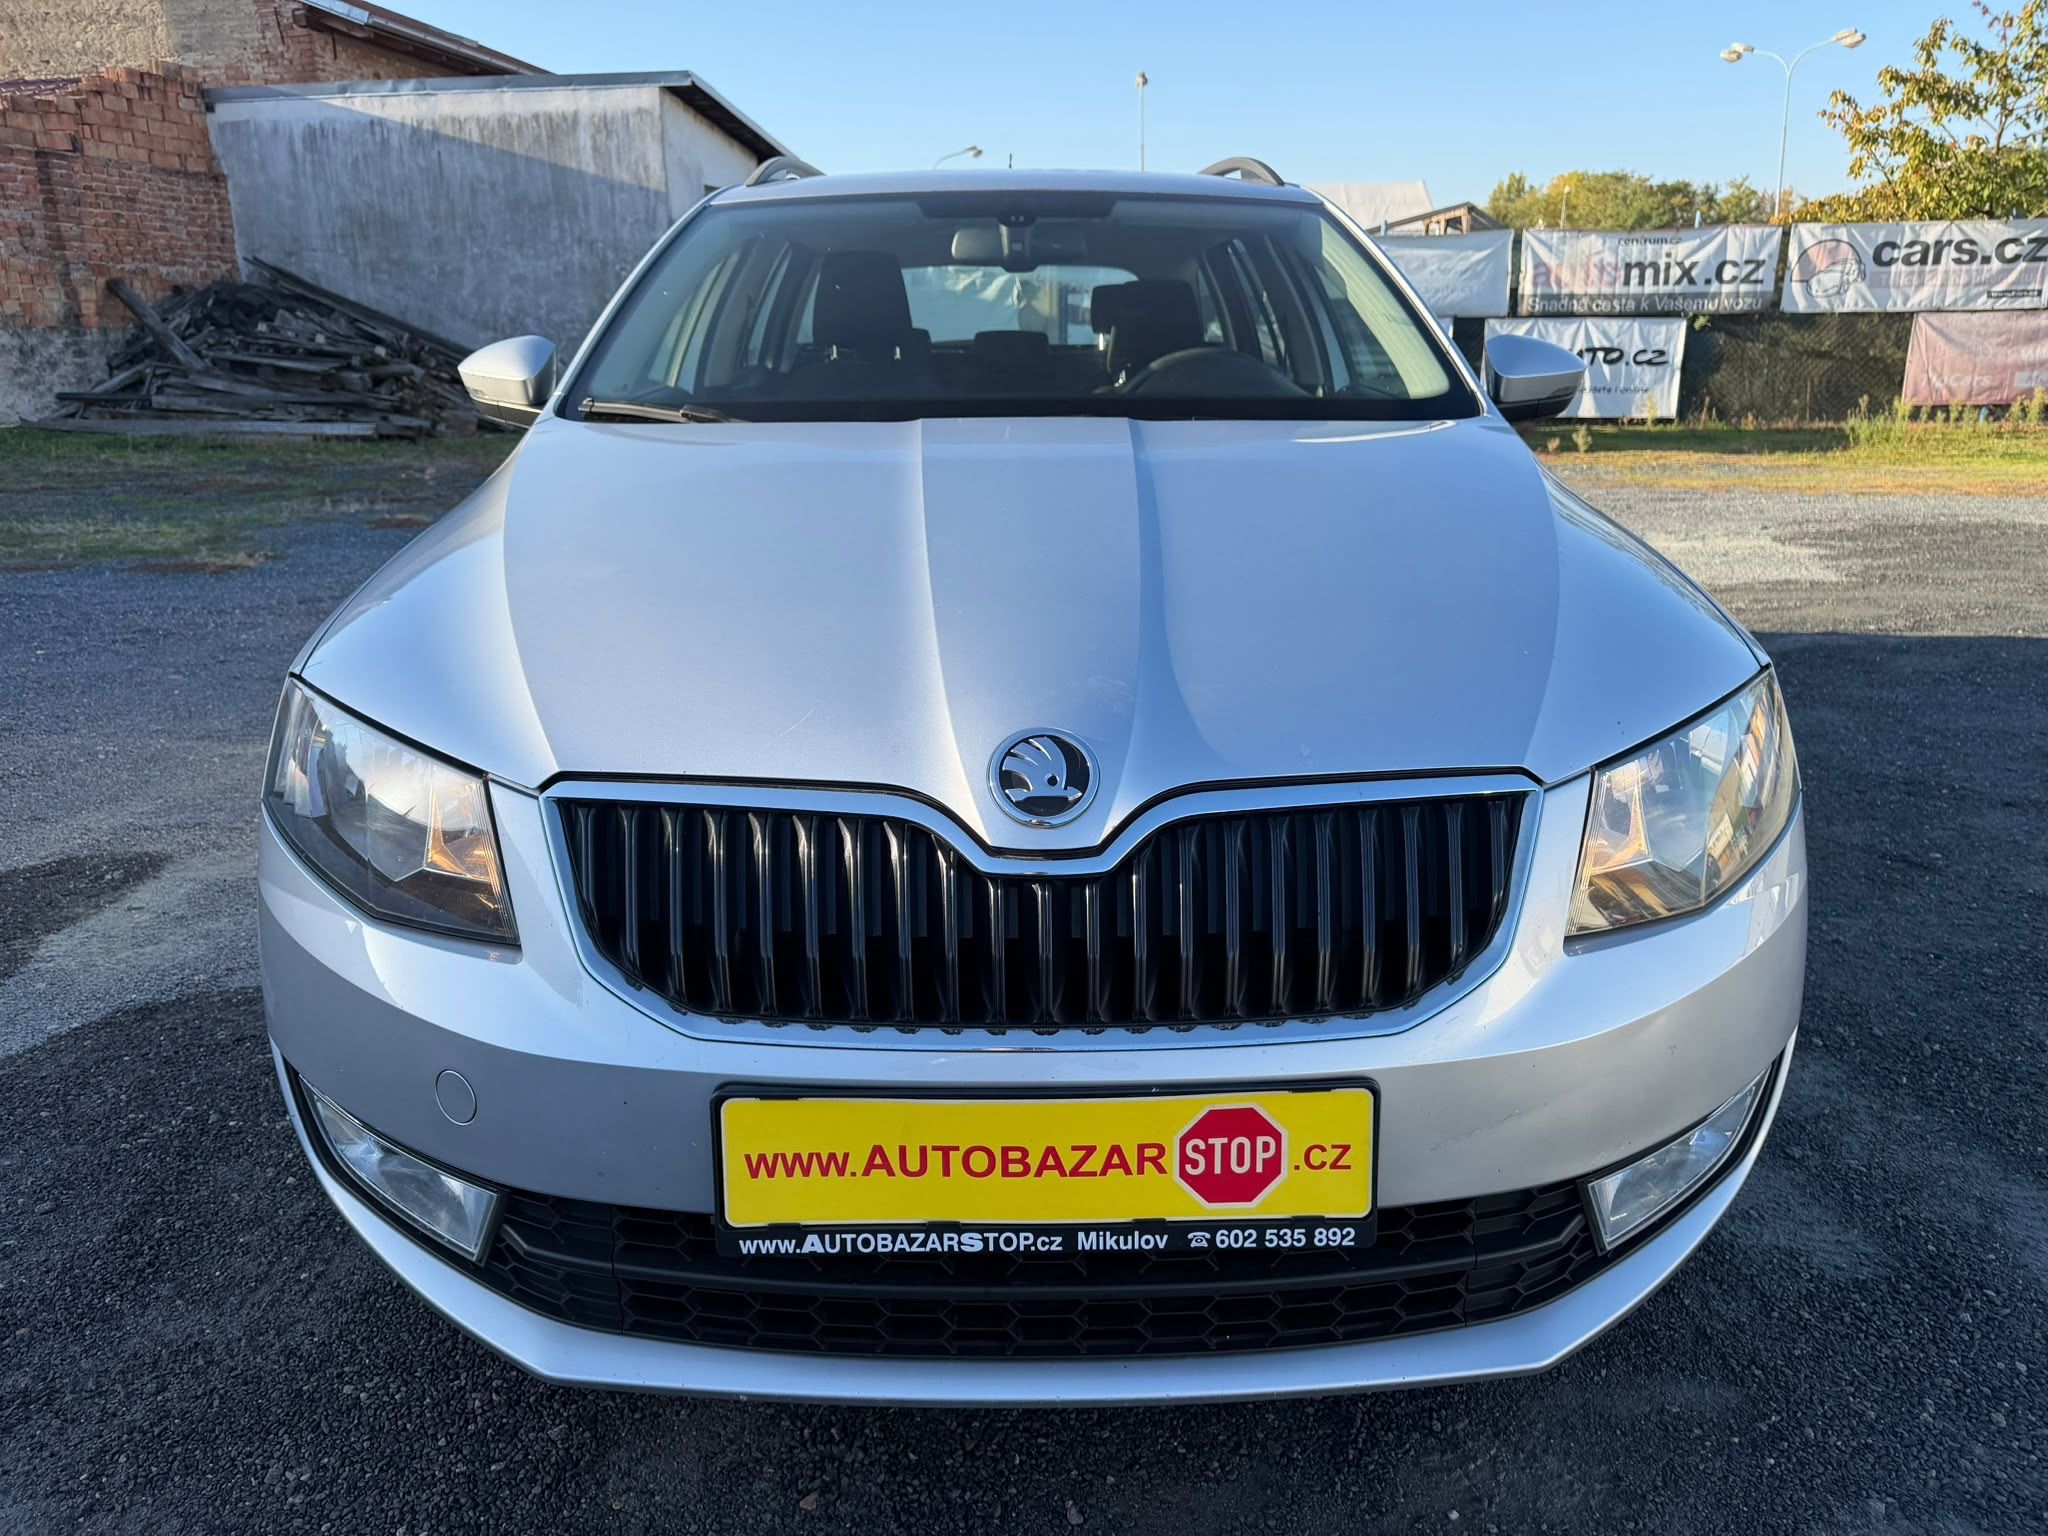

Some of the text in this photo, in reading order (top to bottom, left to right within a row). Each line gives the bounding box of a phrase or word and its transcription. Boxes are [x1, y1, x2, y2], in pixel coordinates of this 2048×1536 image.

[1872, 236, 2048, 267] cars.cz
[1591, 296, 1635, 312] cesta
[1640, 296, 1649, 312] k
[1723, 297, 1762, 311] vozu
[1184, 1135, 1277, 1176] STOP
[738, 1226, 1356, 1255] www.AUTOBAZARSTOP.cz Mikulov 602 535 892
